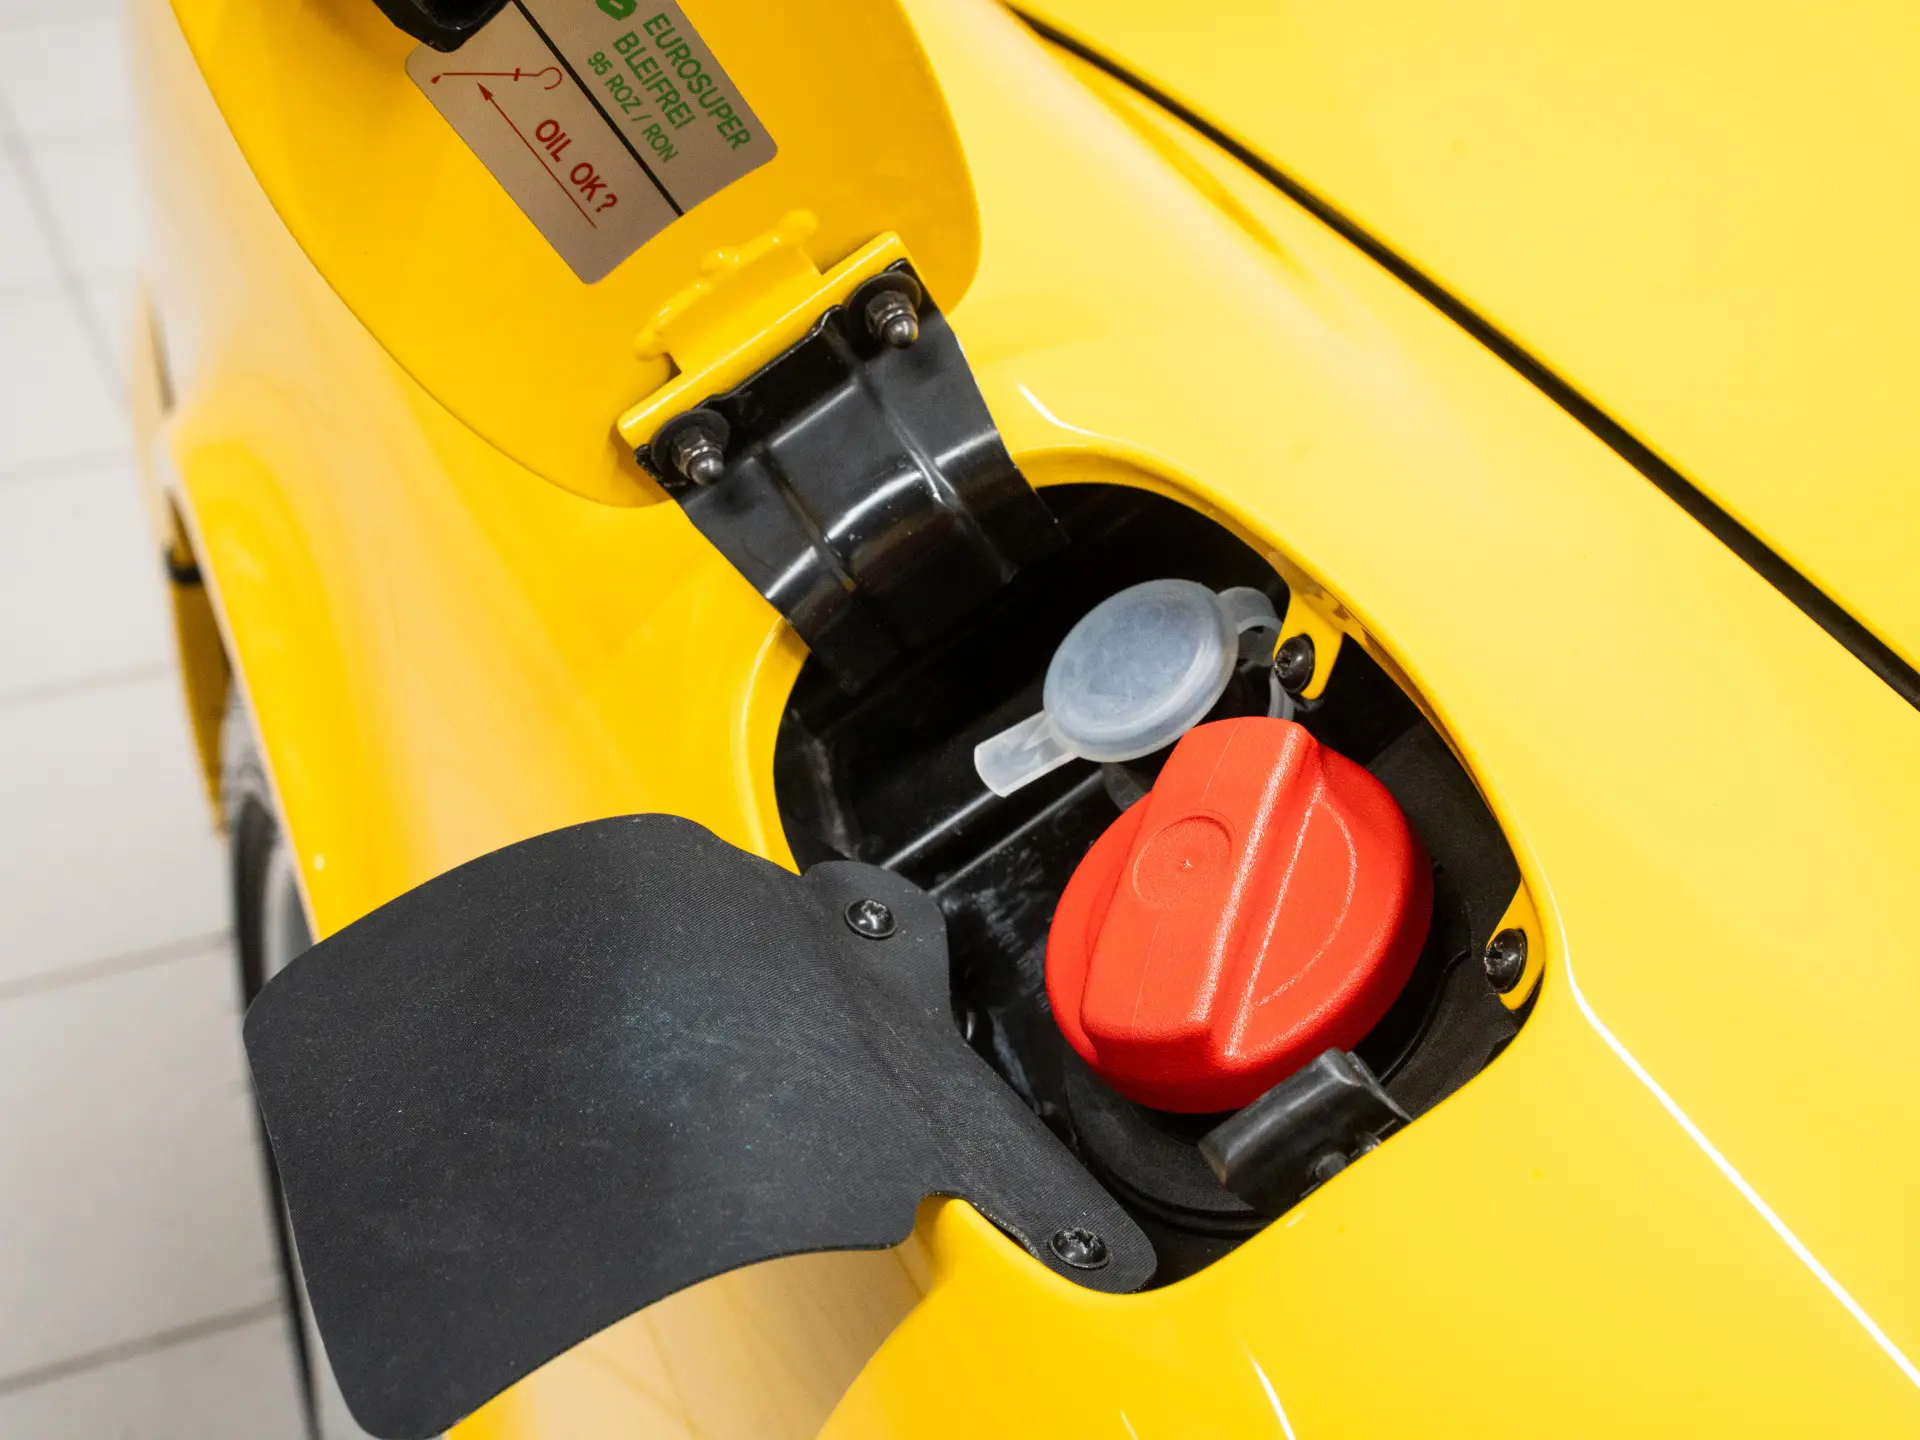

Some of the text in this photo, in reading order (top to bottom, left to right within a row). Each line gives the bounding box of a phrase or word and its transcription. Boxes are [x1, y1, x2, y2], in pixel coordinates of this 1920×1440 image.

[587, 51, 613, 77] 95
[604, 73, 642, 114] ROZ
[642, 123, 679, 163] RON
[613, 31, 697, 130] BLEIFREI
[642, 12, 751, 150] EUROSUPER
[535, 119, 572, 163] OIL
